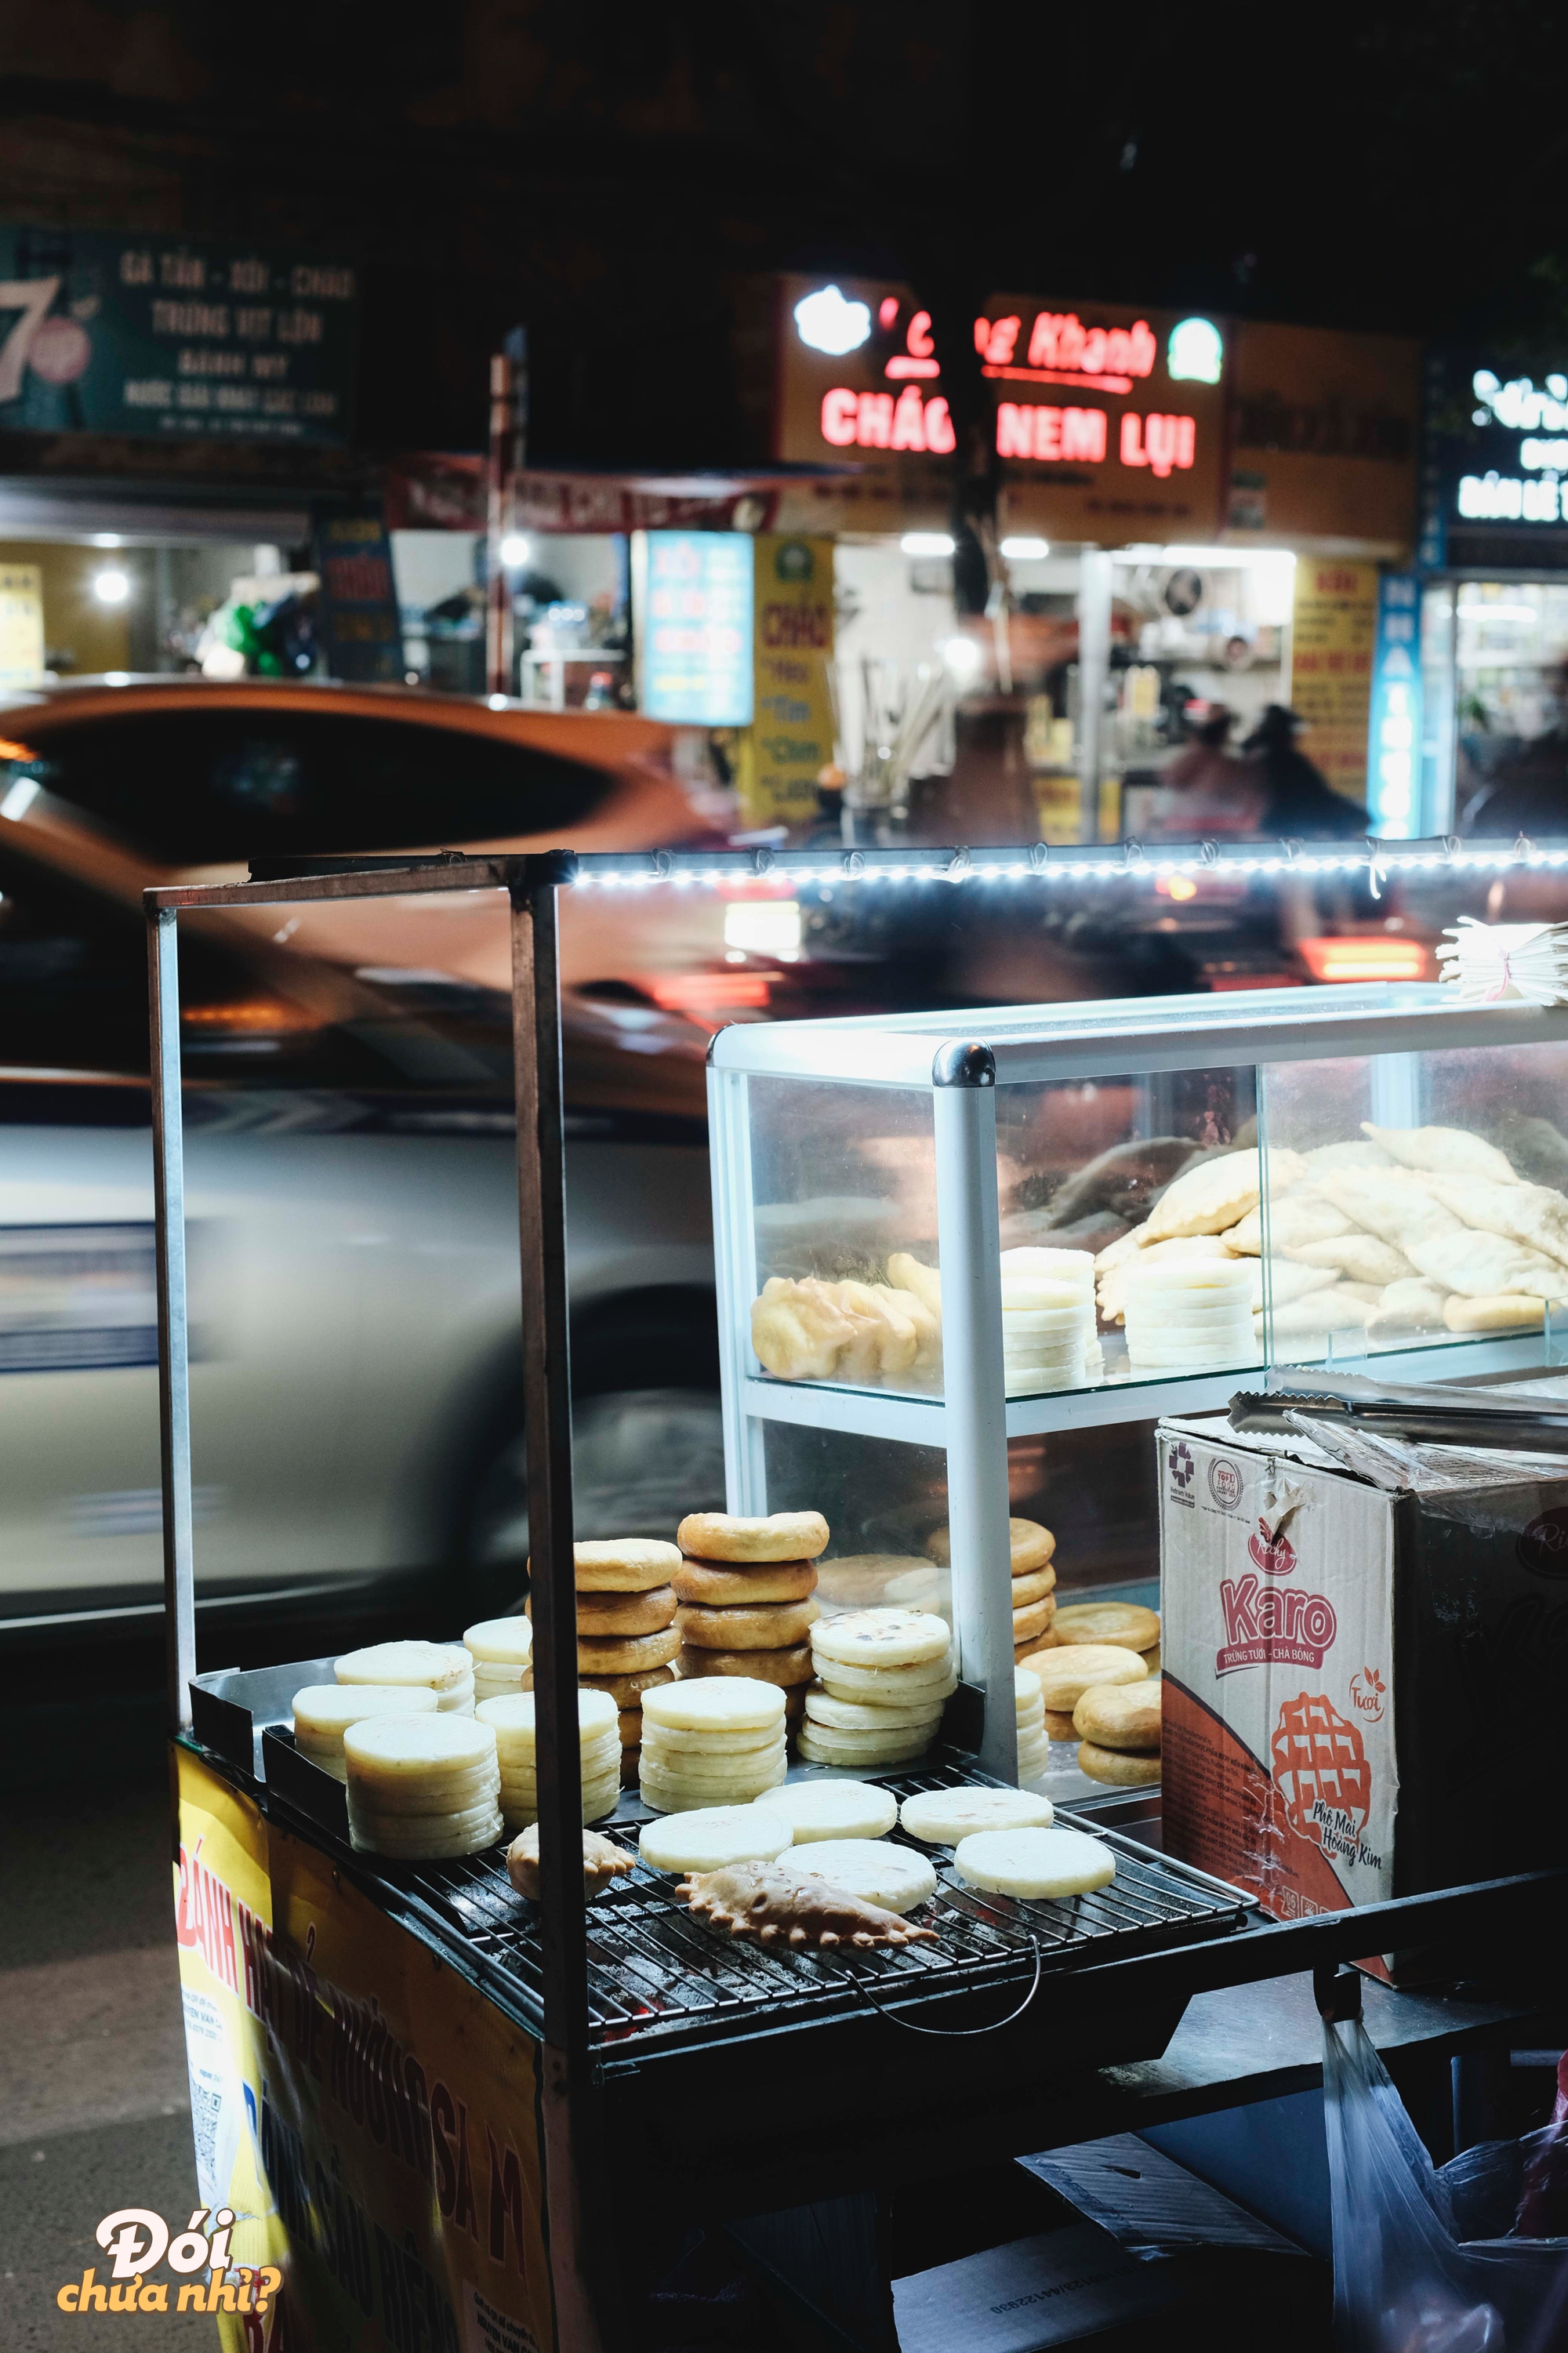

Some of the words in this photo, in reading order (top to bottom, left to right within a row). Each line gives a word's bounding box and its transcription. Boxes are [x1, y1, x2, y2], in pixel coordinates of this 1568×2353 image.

[996, 401, 1108, 463] NEM
[1120, 411, 1196, 478] LỤI
[1221, 1576, 1335, 1648] Karo
[1223, 1649, 1247, 1664] TRỨNG
[1272, 1646, 1290, 1659] CHÀ
[1292, 1647, 1315, 1662] BÔNG
[1313, 1801, 1334, 1826] Phô
[1334, 1811, 1356, 1838] Mai
[1323, 1828, 1356, 1867] Hoàng
[1357, 1843, 1382, 1870] Kim
[1286, 1891, 1296, 1909] 06
